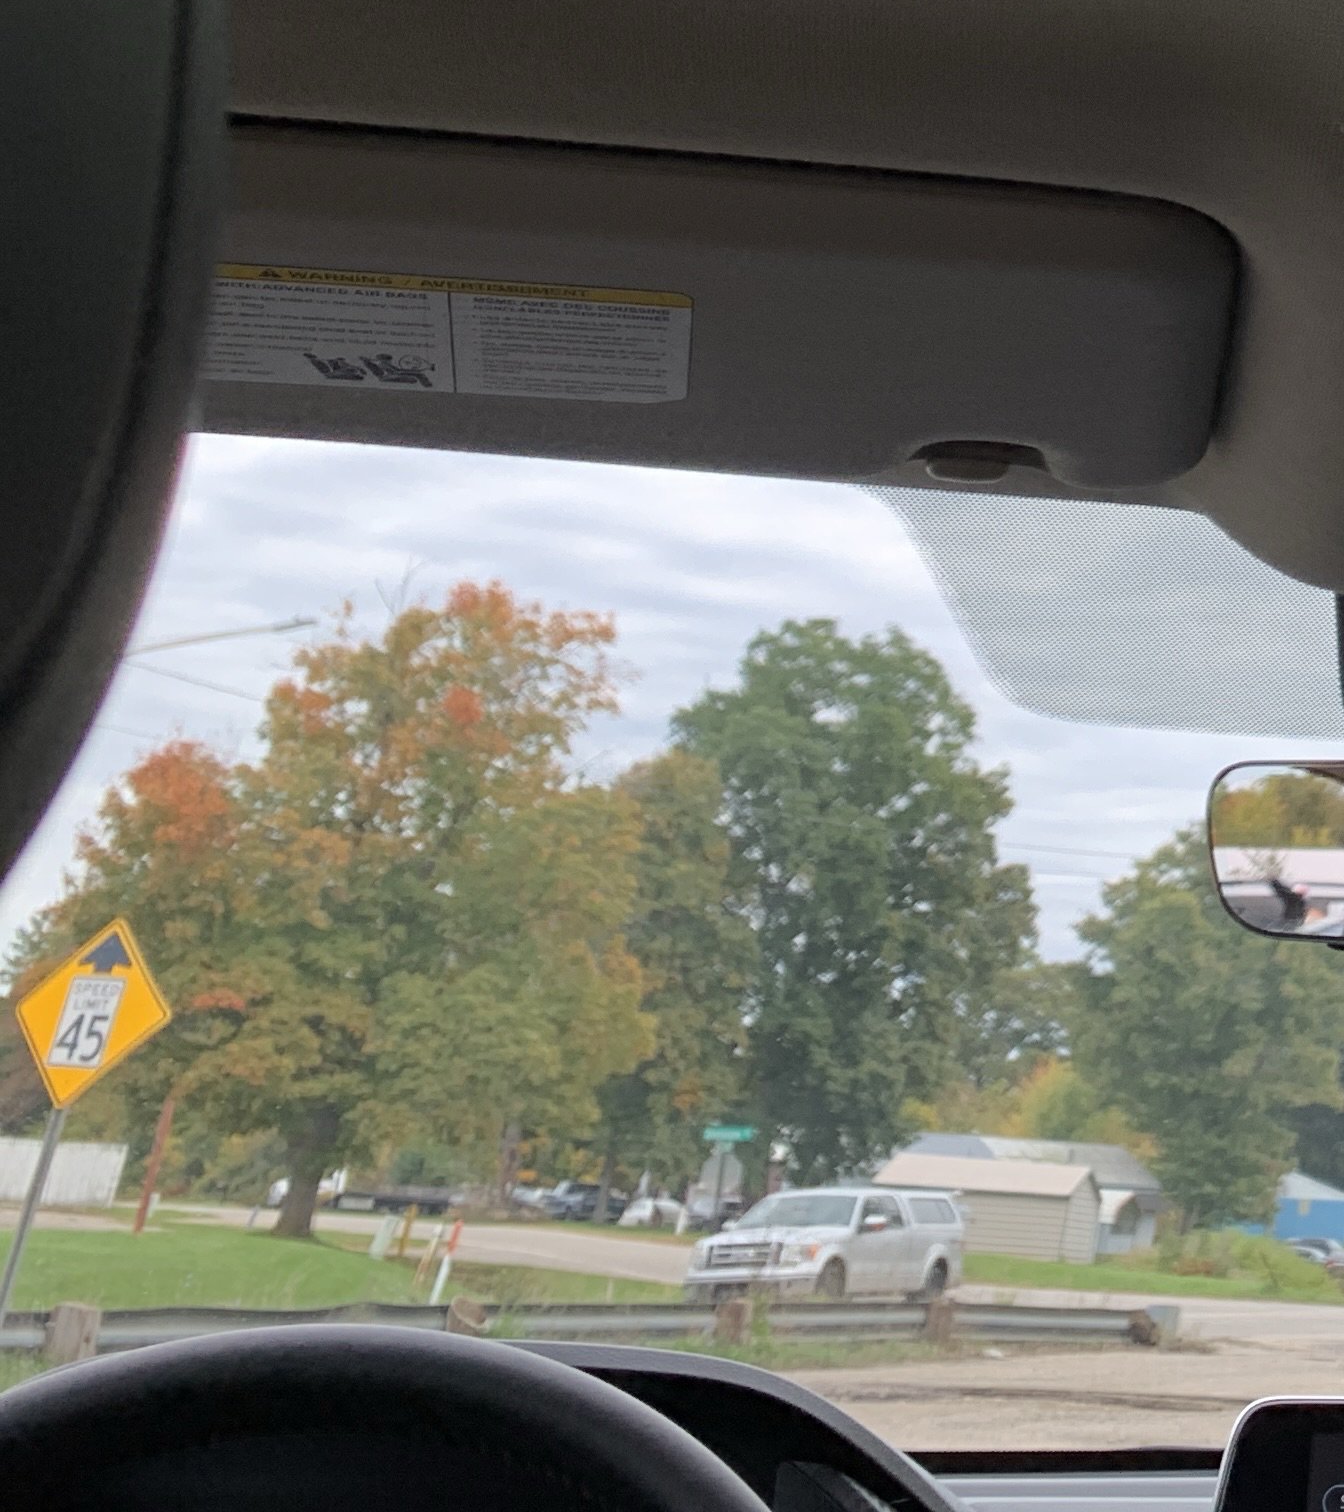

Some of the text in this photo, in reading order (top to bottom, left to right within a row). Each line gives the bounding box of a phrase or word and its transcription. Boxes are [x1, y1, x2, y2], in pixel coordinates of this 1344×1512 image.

[74, 982, 121, 997] SPEED
[73, 998, 110, 1011] LIMIT
[56, 1013, 110, 1062] 45
